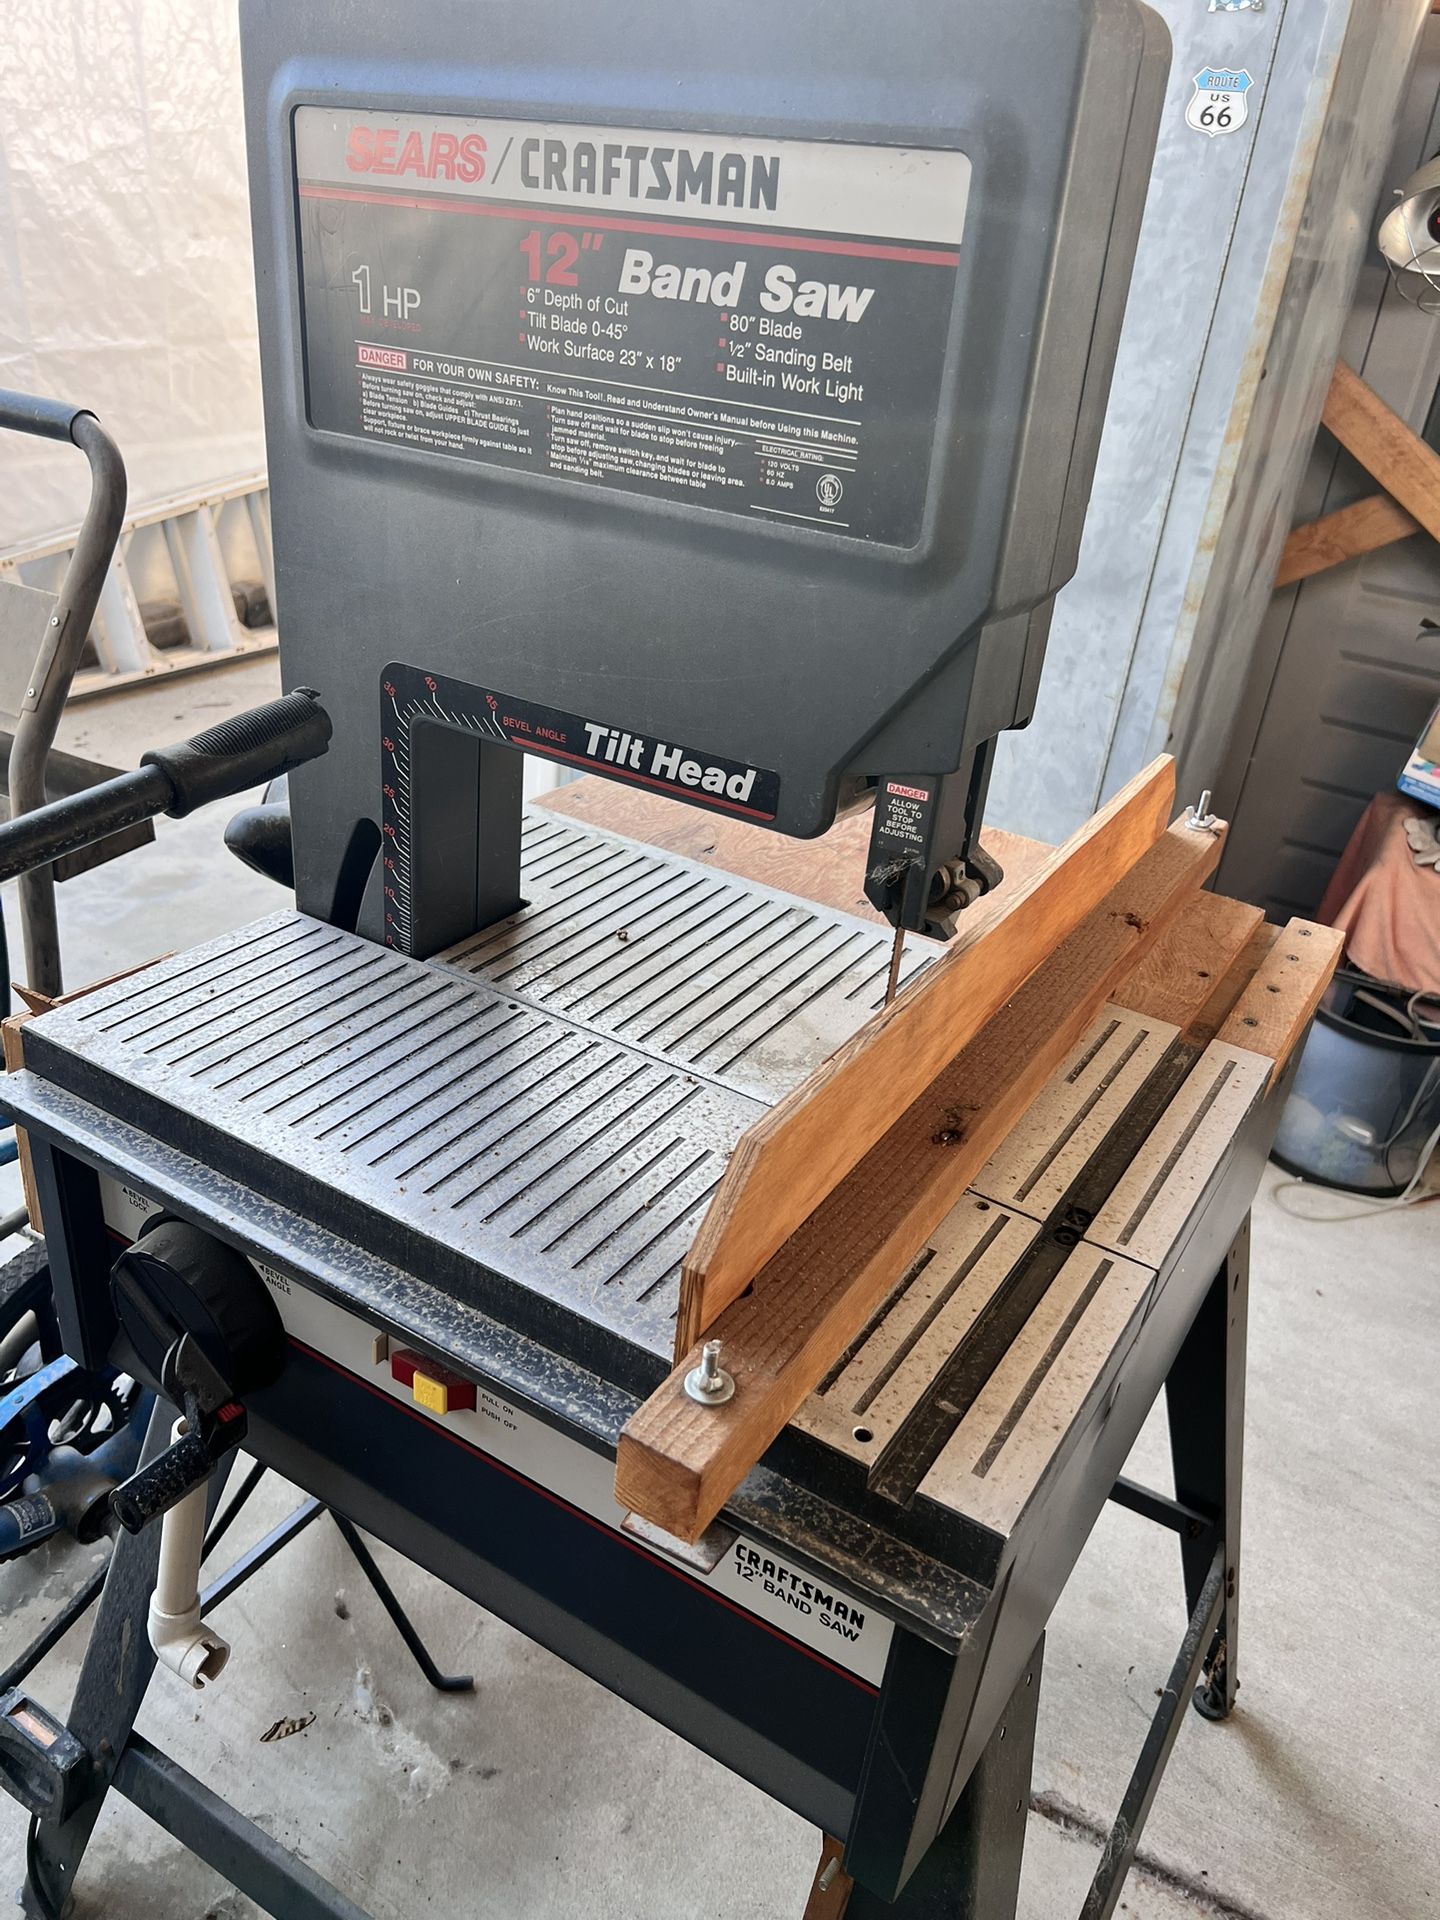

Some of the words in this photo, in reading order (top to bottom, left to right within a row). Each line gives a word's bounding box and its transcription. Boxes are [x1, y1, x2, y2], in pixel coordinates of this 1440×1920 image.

[1207, 75, 1239, 88] ROUTE
[1210, 93, 1231, 102] US
[1200, 105, 1232, 127] 66
[344, 126, 488, 184] SEARS
[520, 138, 781, 211] CRAFTSMAN
[519, 230, 604, 288] 12"
[618, 248, 747, 308] Band
[760, 264, 875, 323] Saw
[352, 265, 371, 314] 1
[383, 285, 421, 320] HP
[526, 287, 541, 303] 6"
[544, 289, 583, 311] Depth
[587, 295, 601, 312] of
[604, 298, 629, 316] Cut
[527, 311, 547, 329] Tilt
[550, 314, 588, 334] Blade
[592, 320, 629, 340] 0-45°
[729, 314, 756, 332] 80"
[758, 318, 803, 340] Blade
[361, 348, 405, 367] DANGER
[527, 334, 560, 353] Work
[563, 340, 615, 362] Surface
[619, 349, 642, 366] 23"
[645, 356, 654, 369] x
[660, 355, 682, 372] 18"
[754, 343, 817, 372] Sanding
[822, 352, 853, 373] Belt
[726, 364, 776, 388] Built-in
[781, 372, 821, 395] Work
[825, 379, 864, 403] Light
[413, 358, 434, 373] FOR
[436, 362, 465, 378] YOUR
[467, 368, 493, 382] OWN
[495, 372, 540, 390] SAFETY:
[546, 384, 567, 395] Know
[568, 387, 583, 398] This
[607, 394, 626, 405] Read
[626, 399, 641, 407] and
[642, 400, 686, 415] Understand
[687, 407, 719, 421] Owner's
[720, 412, 749, 426] Manual
[750, 418, 776, 431] before
[777, 423, 801, 437] Using
[803, 427, 819, 438] this
[820, 429, 859, 445] Machine.
[362, 398, 381, 408] Before
[444, 413, 466, 424] UPPER
[466, 417, 488, 428] BLADE
[488, 422, 509, 432] GUIDE
[509, 426, 517, 434] to
[517, 427, 530, 436] just
[551, 405, 566, 415] Plan
[566, 408, 583, 418] hand
[583, 412, 615, 424] positions
[616, 418, 625, 426] so
[631, 420, 657, 431] sudden
[657, 425, 671, 436] slip
[671, 428, 691, 438] won't
[692, 431, 714, 442] cause
[551, 424, 577, 436] jammed
[551, 414, 566, 424] Turn
[566, 419, 580, 427] saw
[580, 421, 591, 429] off
[591, 423, 604, 432] and
[604, 426, 619, 434] wait
[619, 427, 630, 436] for
[630, 429, 649, 440] blade
[651, 433, 658, 441] to
[659, 435, 675, 446] stop
[675, 437, 698, 449] before
[699, 441, 724, 455] freeing
[551, 433, 566, 443] Turn
[592, 442, 617, 453] remove
[618, 446, 640, 457] switch
[656, 454, 669, 462] and
[670, 457, 685, 466] wait
[686, 459, 696, 468] for
[697, 461, 717, 472] blade
[718, 466, 726, 474] to
[762, 445, 799, 457] ELECTRICAL
[550, 462, 562, 470] and
[563, 464, 589, 476] sanding
[550, 451, 578, 463] Maintain
[592, 461, 625, 473] maximum
[626, 467, 659, 480] clearance
[659, 472, 688, 485] between
[689, 479, 707, 489] table
[551, 443, 566, 453] stop
[566, 446, 587, 456] before
[588, 451, 619, 464] adjusting
[635, 459, 666, 473] changing
[667, 465, 690, 477] blades
[691, 470, 700, 478] or
[700, 471, 727, 485] leaving
[780, 462, 800, 472] VOLTS
[383, 681, 397, 697] 35
[424, 676, 437, 691] 40
[485, 695, 498, 710] 45
[502, 716, 532, 733] BEVEL
[535, 726, 567, 744] ANGLE
[383, 736, 395, 752] 30
[584, 722, 645, 770] Tilt
[650, 743, 757, 802] Head
[383, 784, 396, 798] 25
[888, 784, 927, 800] DANGER
[887, 804, 909, 816] TOOL
[910, 810, 922, 819] TO
[890, 798, 920, 811] ALLOW
[886, 820, 917, 833] BEFORE
[892, 814, 914, 824] STOP
[383, 823, 396, 837] 20
[879, 826, 923, 843] ADJUSTING
[384, 856, 395, 870] 15
[384, 886, 395, 898] 10
[386, 913, 393, 922] 5
[386, 935, 393, 945] 0
[129, 1190, 150, 1208] BEVEL
[129, 1197, 148, 1213] LOCK
[265, 1267, 290, 1286] BEVEL
[265, 1276, 292, 1296] ANGLE
[482, 1393, 500, 1408] PULL
[503, 1405, 514, 1416] ON
[481, 1406, 501, 1423] PUSH
[503, 1419, 518, 1431] OFF
[735, 1543, 865, 1630] CRAFTSMAN
[763, 1579, 812, 1615] BAND
[819, 1612, 860, 1643] SAW
